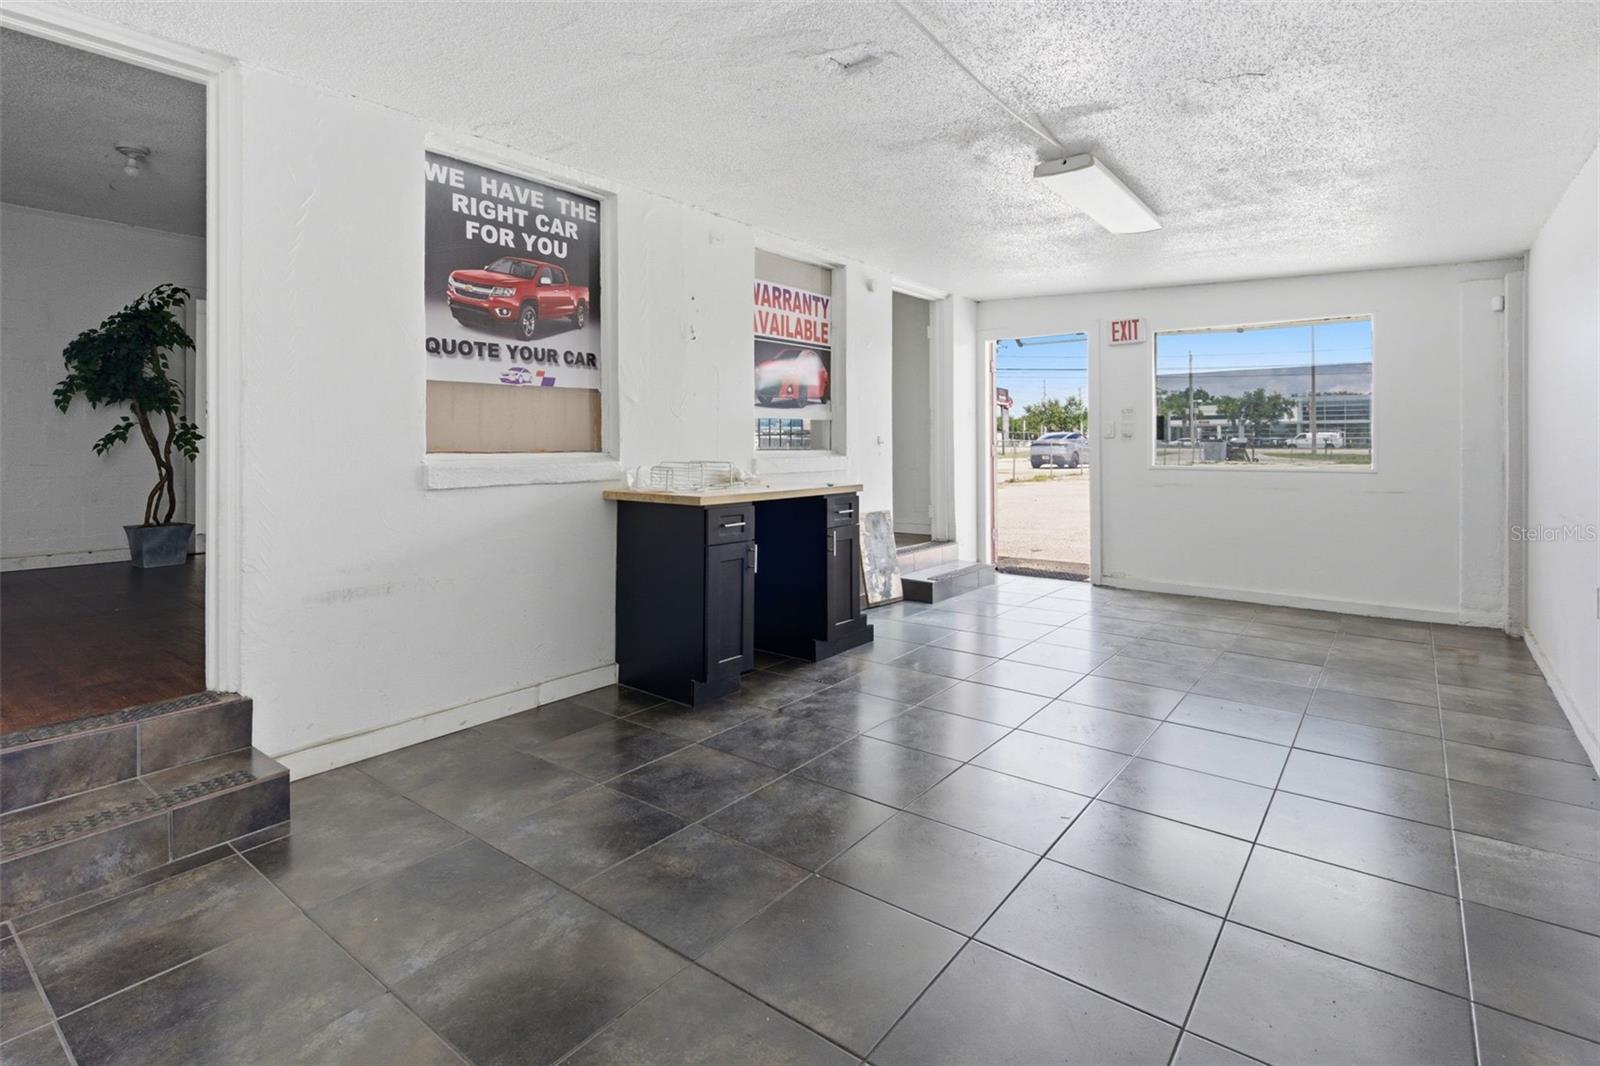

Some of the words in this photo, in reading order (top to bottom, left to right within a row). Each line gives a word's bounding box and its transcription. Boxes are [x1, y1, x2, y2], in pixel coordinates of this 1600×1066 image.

[424, 161, 465, 189] WE
[481, 177, 544, 208] HAVE
[557, 198, 597, 223] THE
[452, 193, 528, 228] RIGHT
[536, 215, 578, 239] CAR
[466, 221, 515, 249] FOR
[522, 233, 568, 259] YOU
[1112, 319, 1140, 342] EXIT
[425, 337, 500, 358] QUOTE
[506, 344, 558, 363] YOUR
[563, 350, 598, 369] CAR
